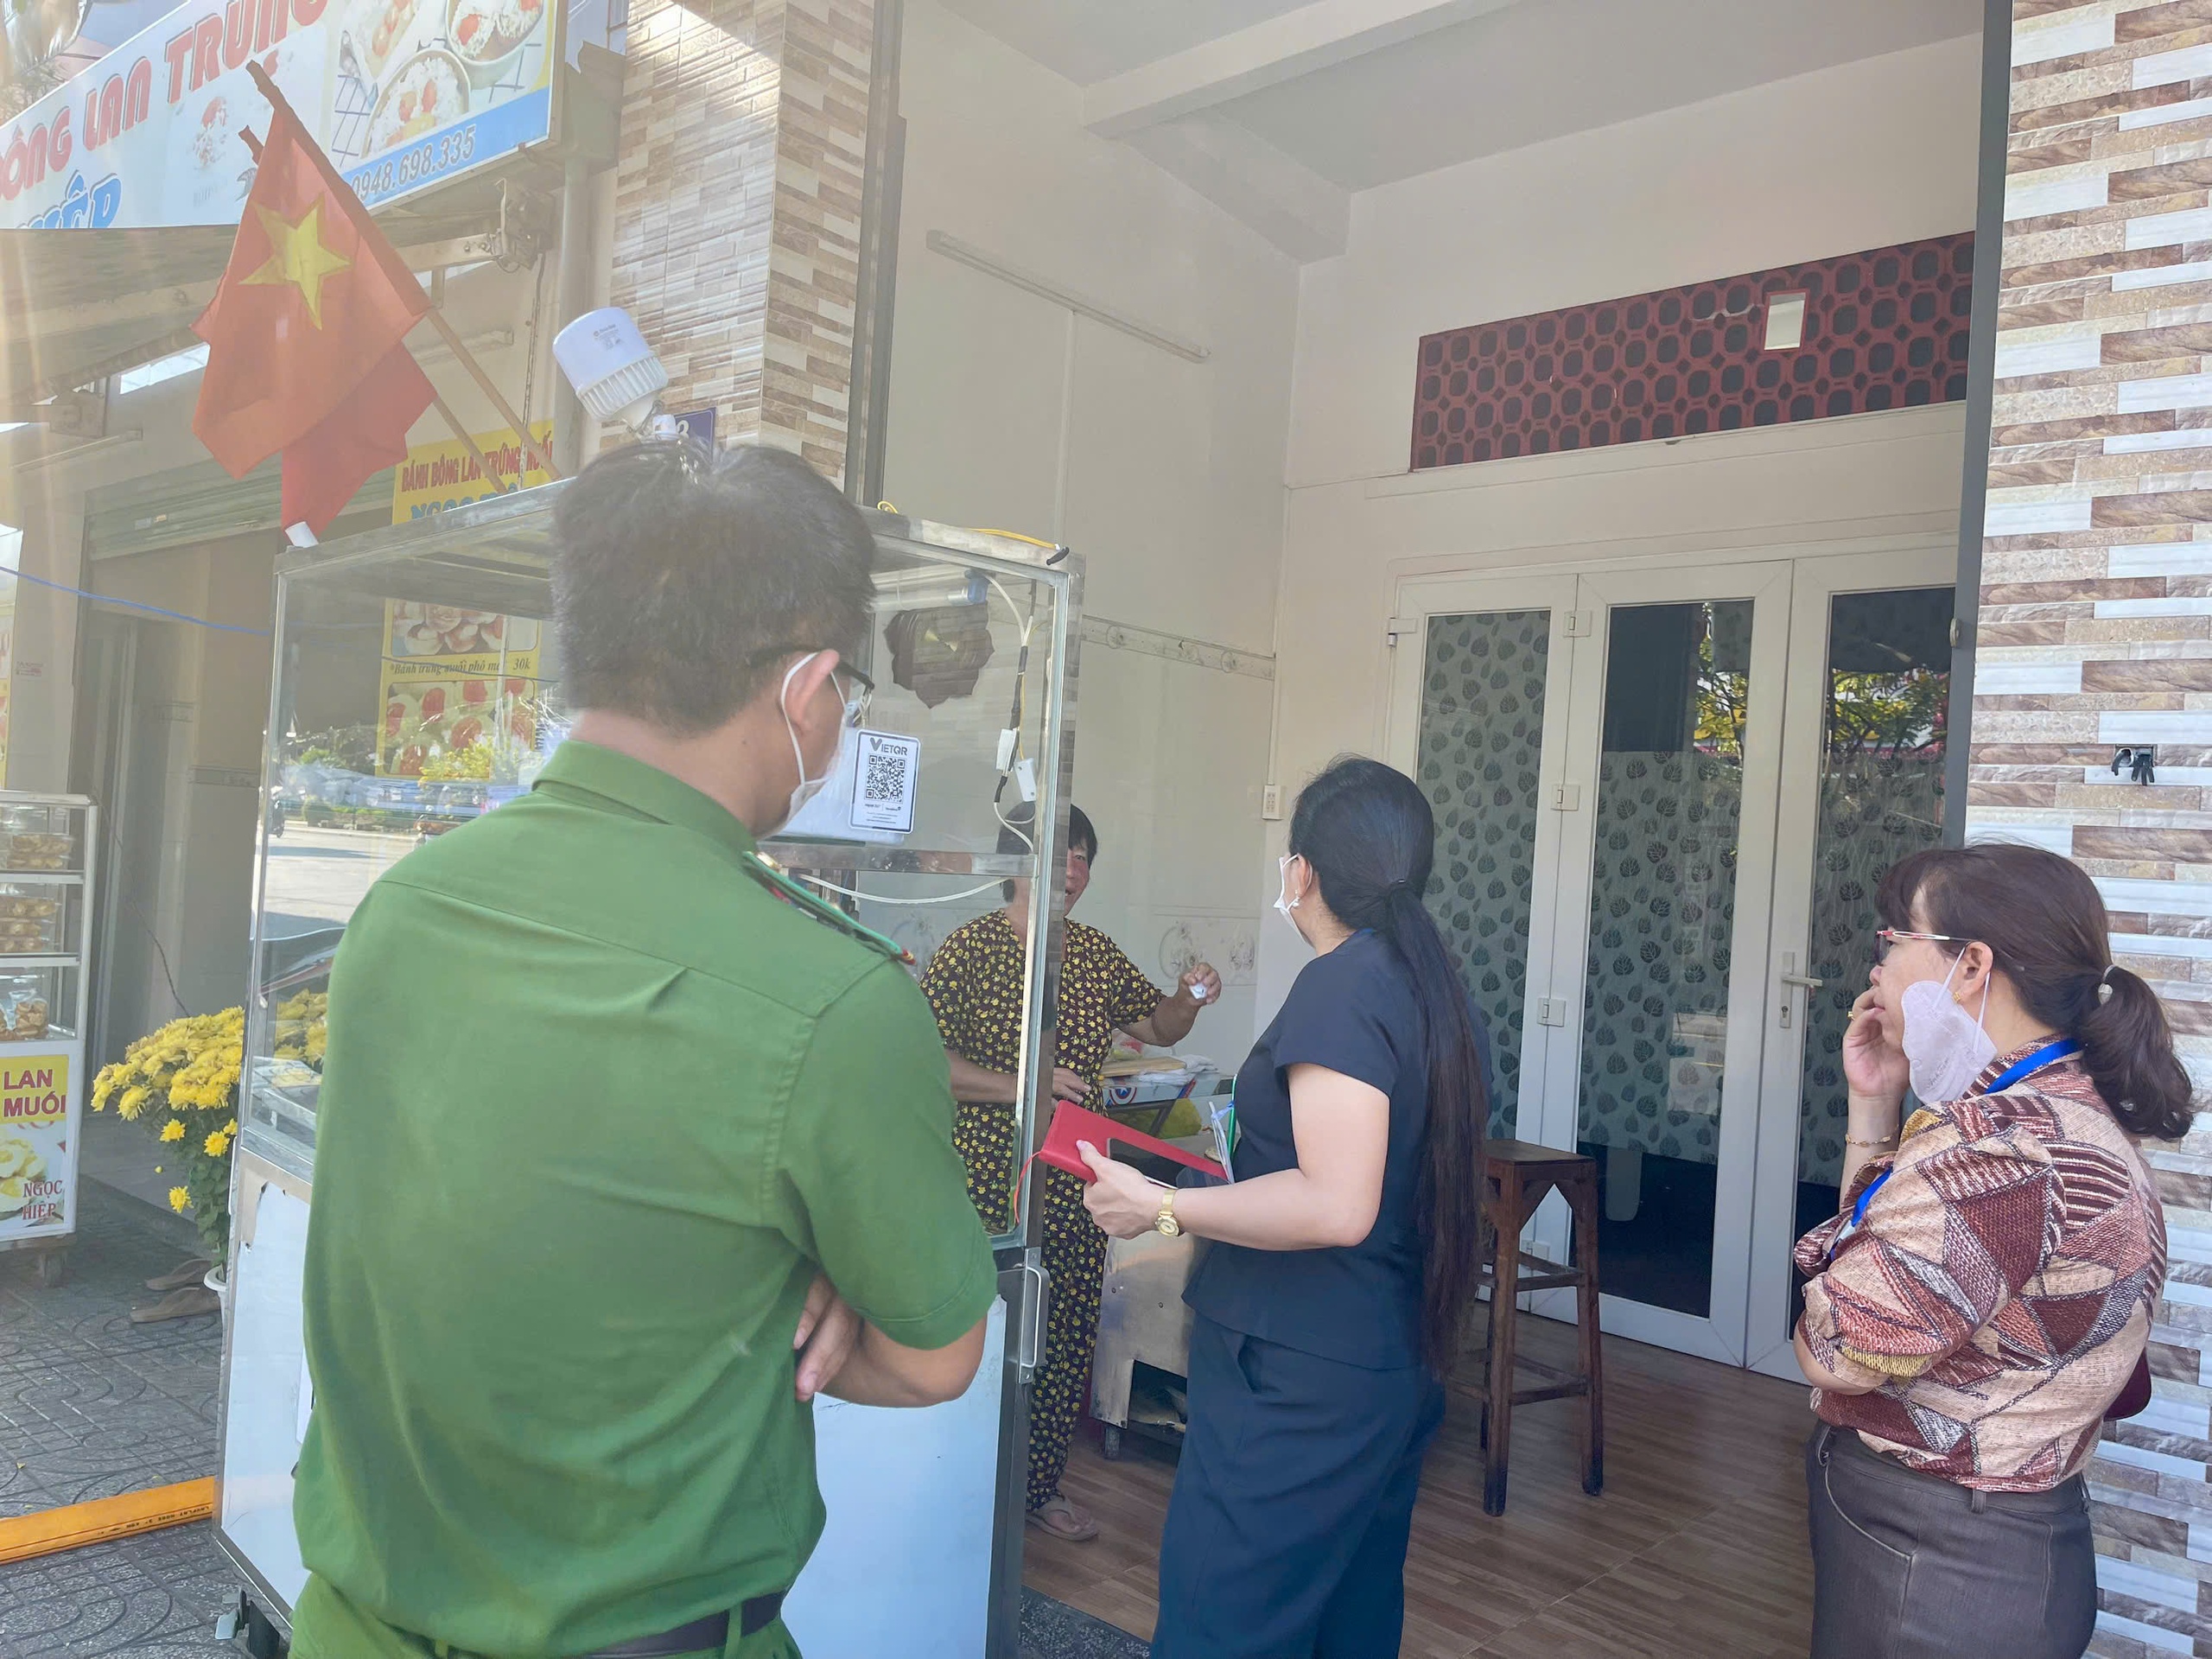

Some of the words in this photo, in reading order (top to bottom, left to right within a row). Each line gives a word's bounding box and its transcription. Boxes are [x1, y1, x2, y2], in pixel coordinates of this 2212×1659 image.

[0, 124, 73, 201] ÔNG
[83, 55, 152, 152] LAN
[401, 460, 429, 493] BÁNH
[430, 454, 460, 487] BÔNG
[512, 658, 531, 670] 30k
[869, 737, 907, 756] VIETQR
[3, 1069, 54, 1090] LAN
[22, 1179, 63, 1199] NGỌC
